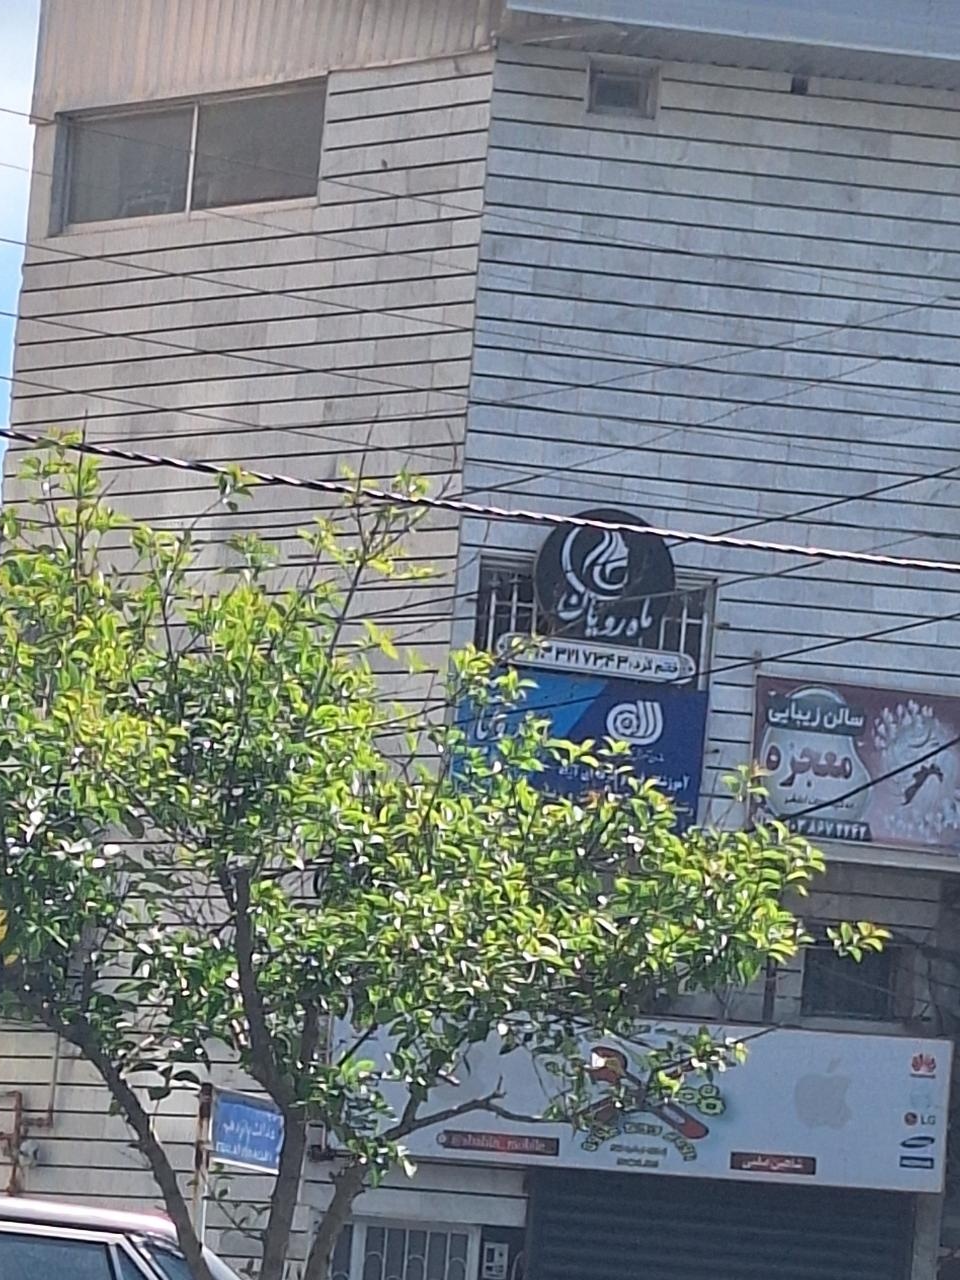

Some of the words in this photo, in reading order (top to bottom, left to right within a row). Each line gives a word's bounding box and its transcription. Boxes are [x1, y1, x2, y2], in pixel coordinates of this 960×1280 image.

[768, 700, 821, 728] زیبایی
[823, 706, 864, 728] سالن
[766, 743, 853, 788] معجزه
[920, 1114, 936, 1126] LG
